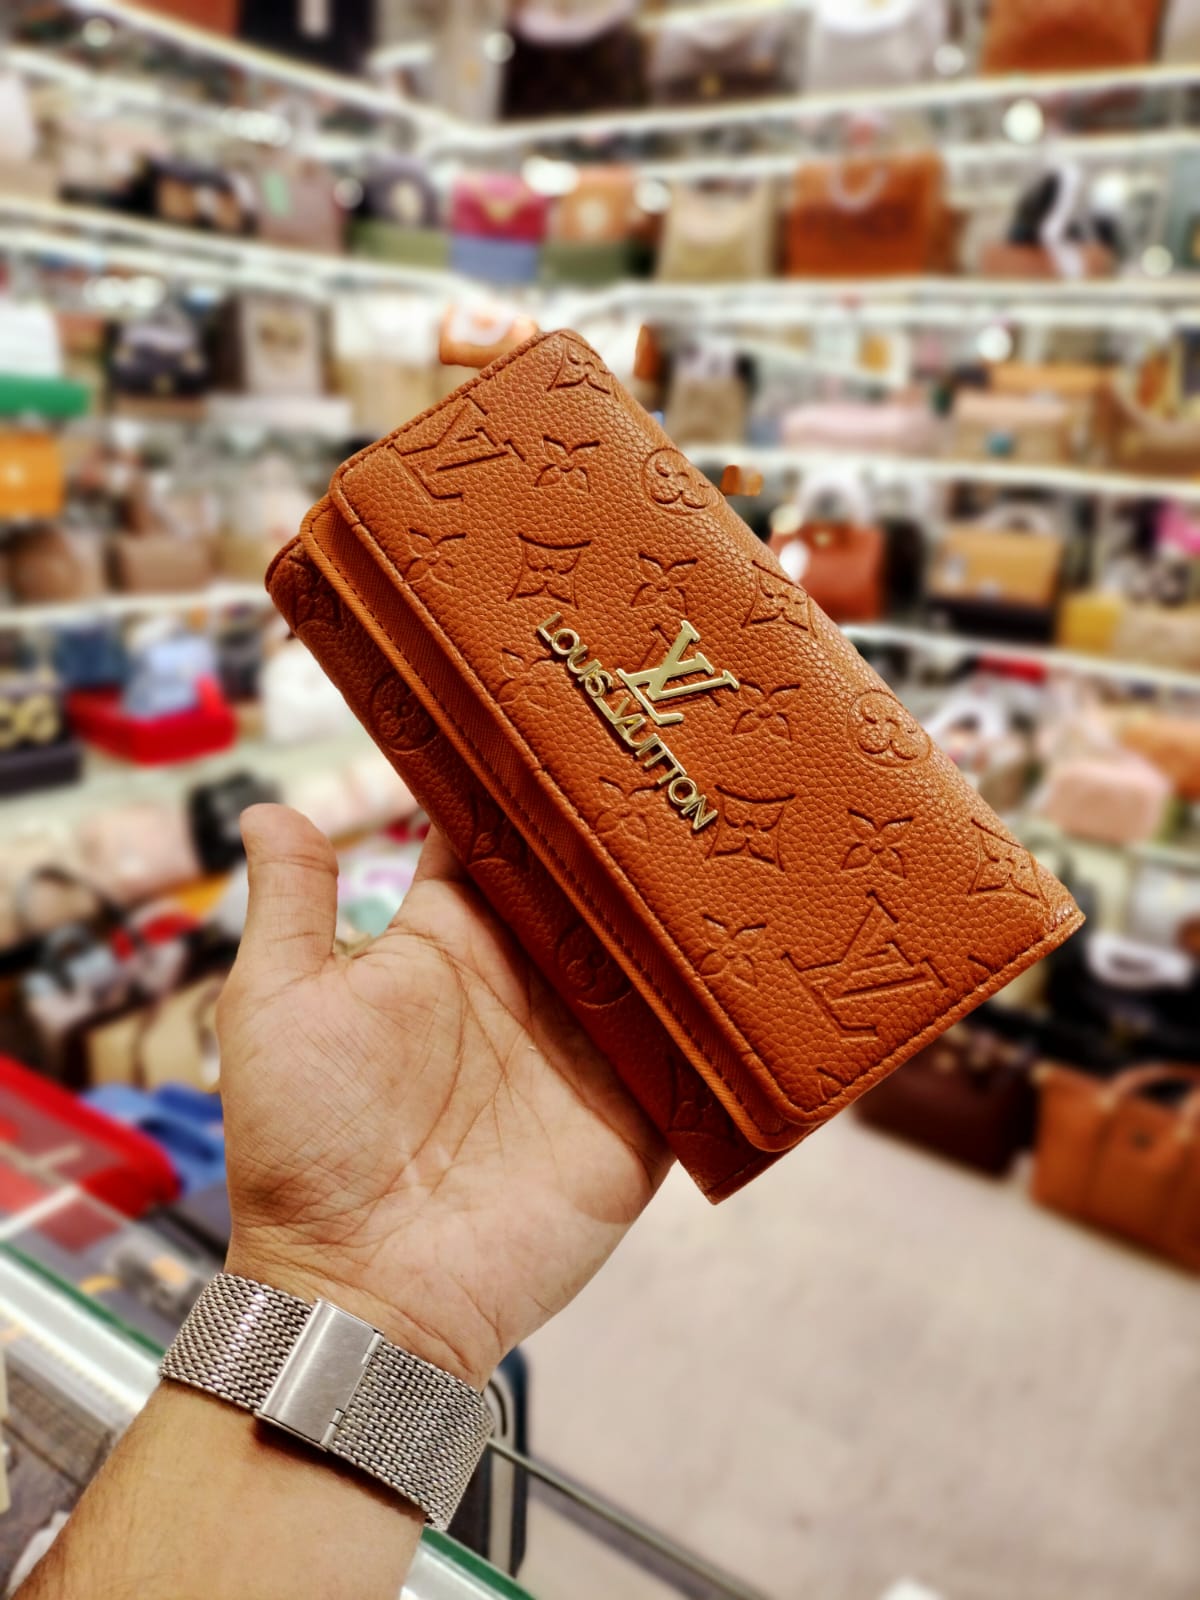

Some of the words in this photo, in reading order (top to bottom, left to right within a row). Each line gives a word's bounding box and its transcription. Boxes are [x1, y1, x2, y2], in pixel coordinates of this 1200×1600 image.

[536, 611, 614, 698] LOUIS
[610, 696, 719, 830] VUITTON
[616, 619, 740, 725] LV
